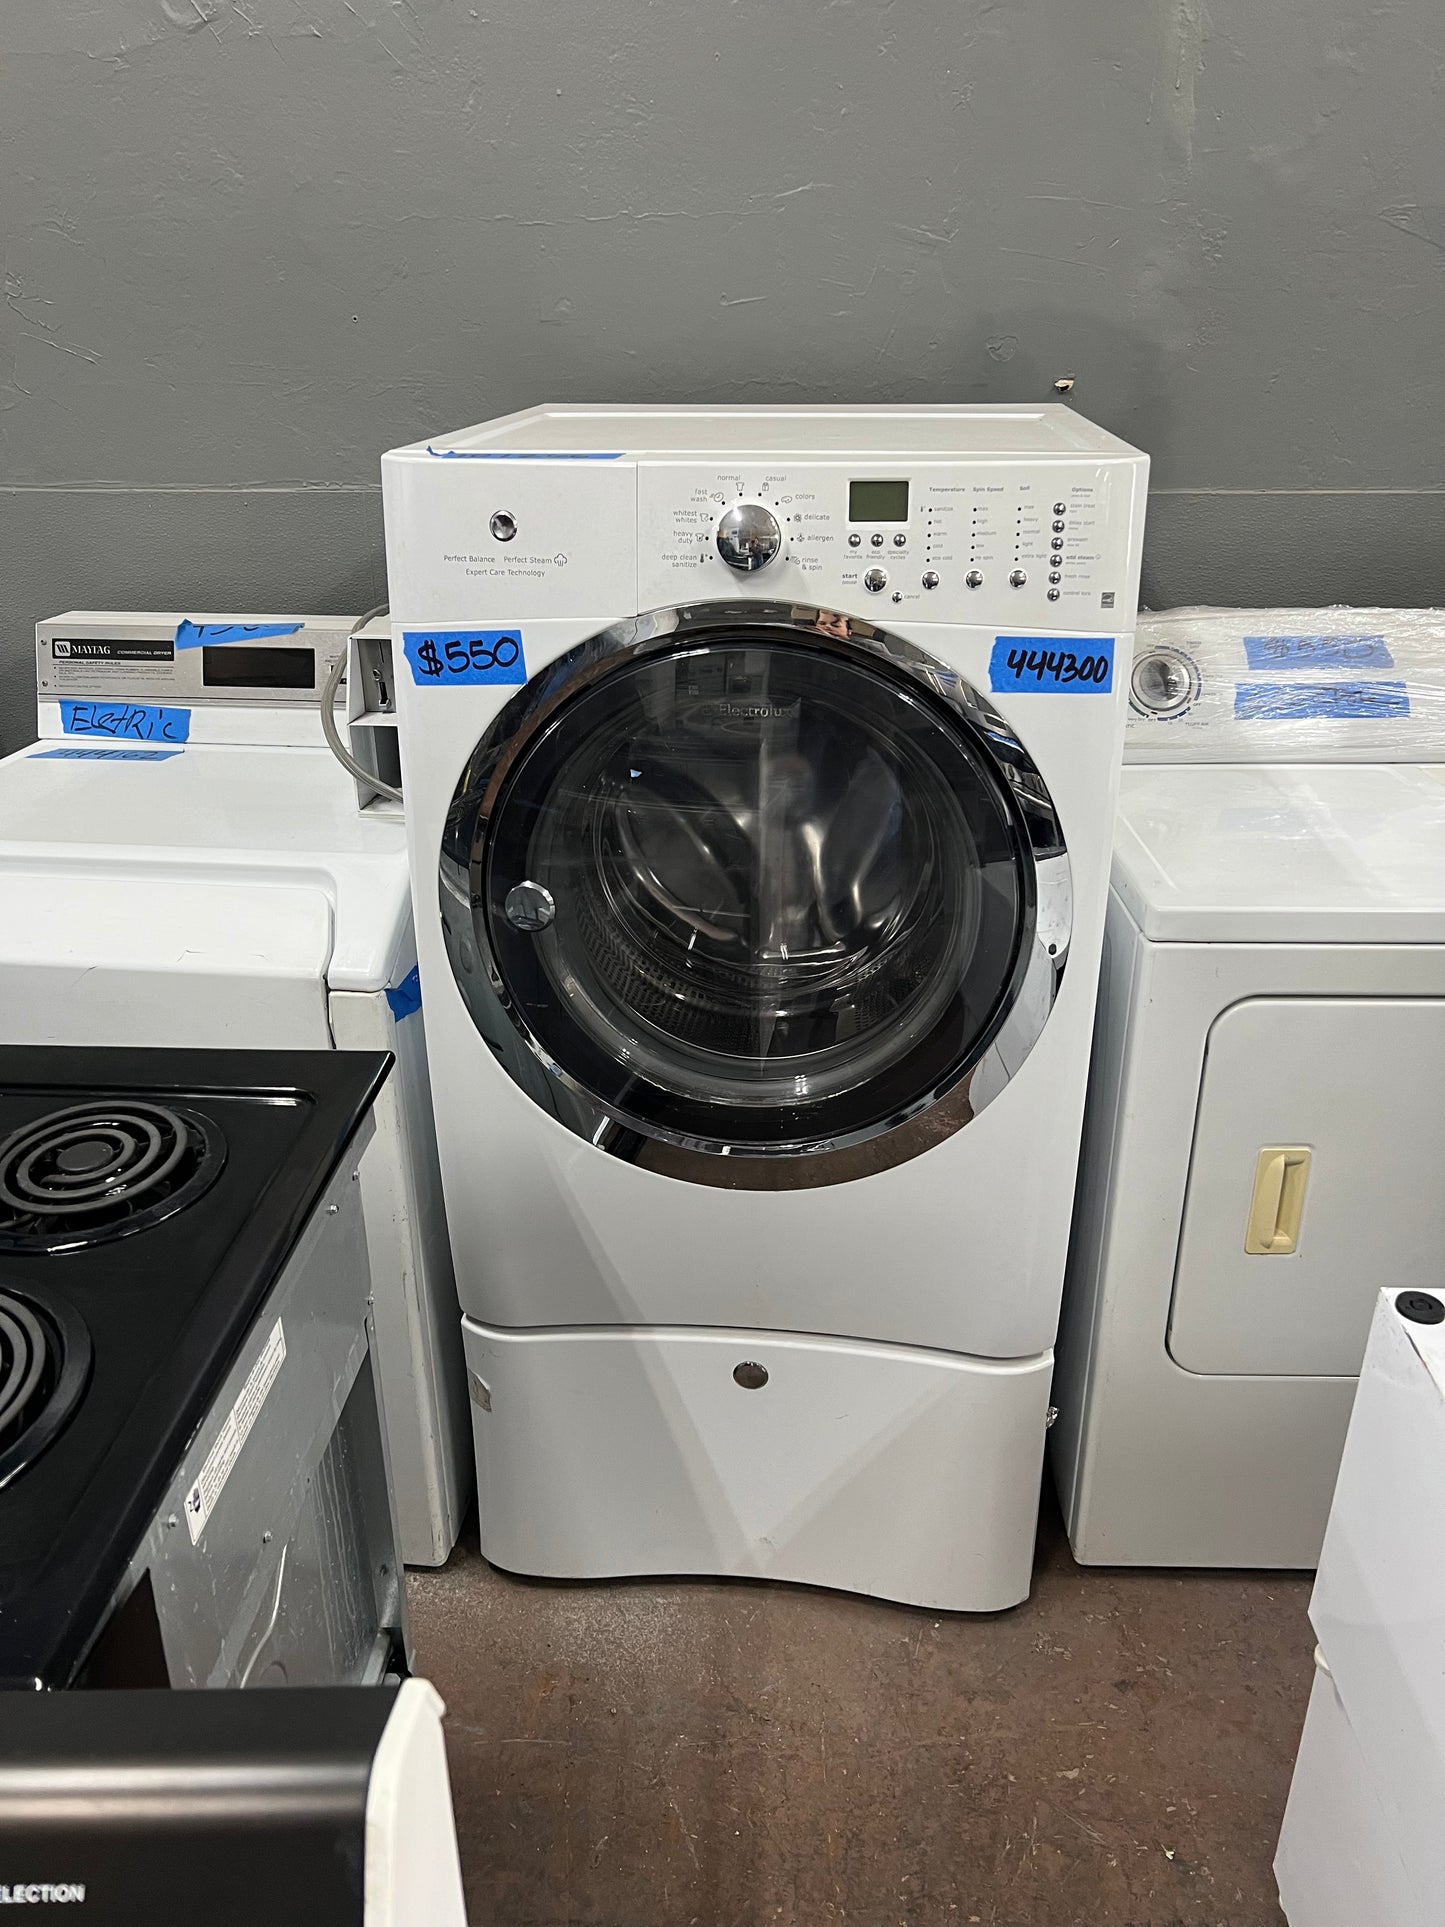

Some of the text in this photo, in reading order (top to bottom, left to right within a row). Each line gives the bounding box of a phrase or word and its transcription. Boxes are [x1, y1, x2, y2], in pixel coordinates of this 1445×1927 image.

[508, 569, 545, 577] Technology
[71, 645, 111, 655] MAYTAG
[418, 637, 519, 677] $550
[1007, 649, 1109, 683] 444300
[719, 703, 793, 717] Electrolux
[0, 1883, 86, 1903] LECTION
